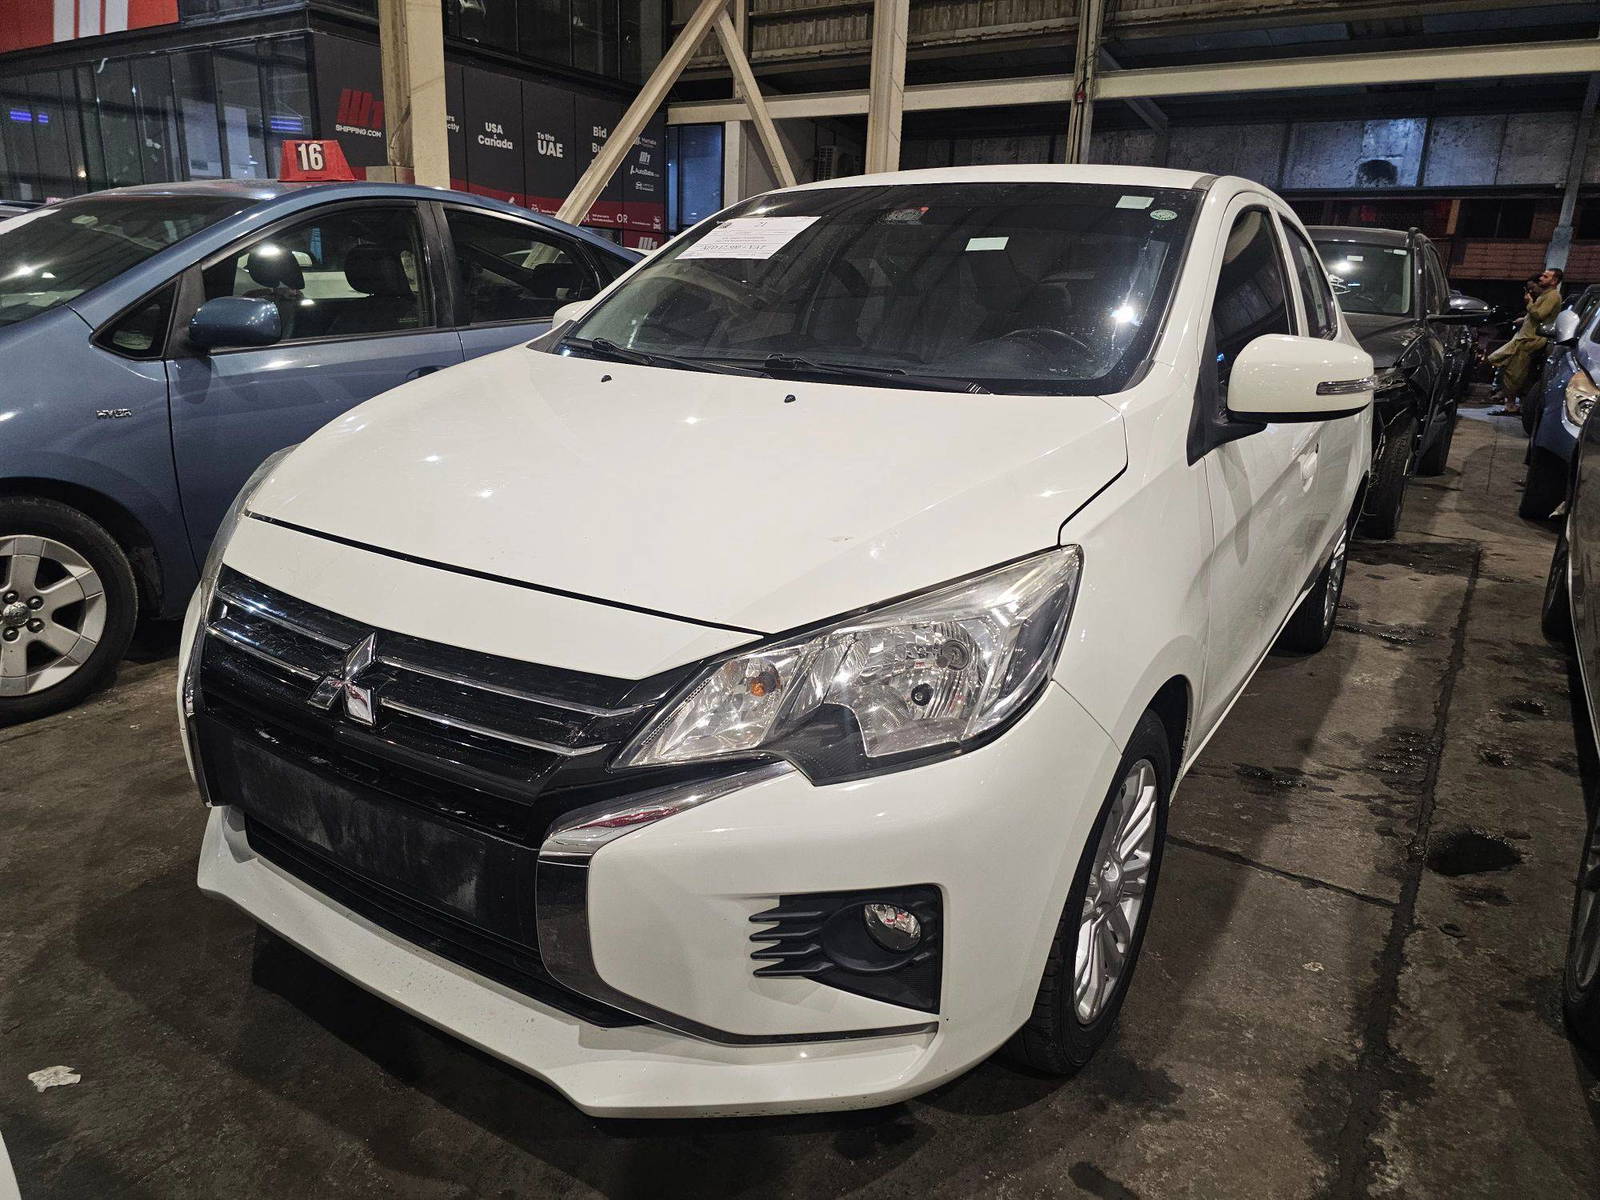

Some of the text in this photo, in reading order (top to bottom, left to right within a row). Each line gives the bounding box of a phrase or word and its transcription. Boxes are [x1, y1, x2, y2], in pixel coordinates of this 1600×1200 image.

[335, 124, 382, 138] SHIPPING.COM
[447, 122, 460, 133] ctly
[485, 122, 503, 135] USA
[592, 125, 607, 138] Bid
[478, 135, 513, 150] Canada
[537, 132, 544, 140] To
[537, 139, 564, 158] UAE
[591, 142, 604, 153] Bu
[298, 143, 323, 171] 16
